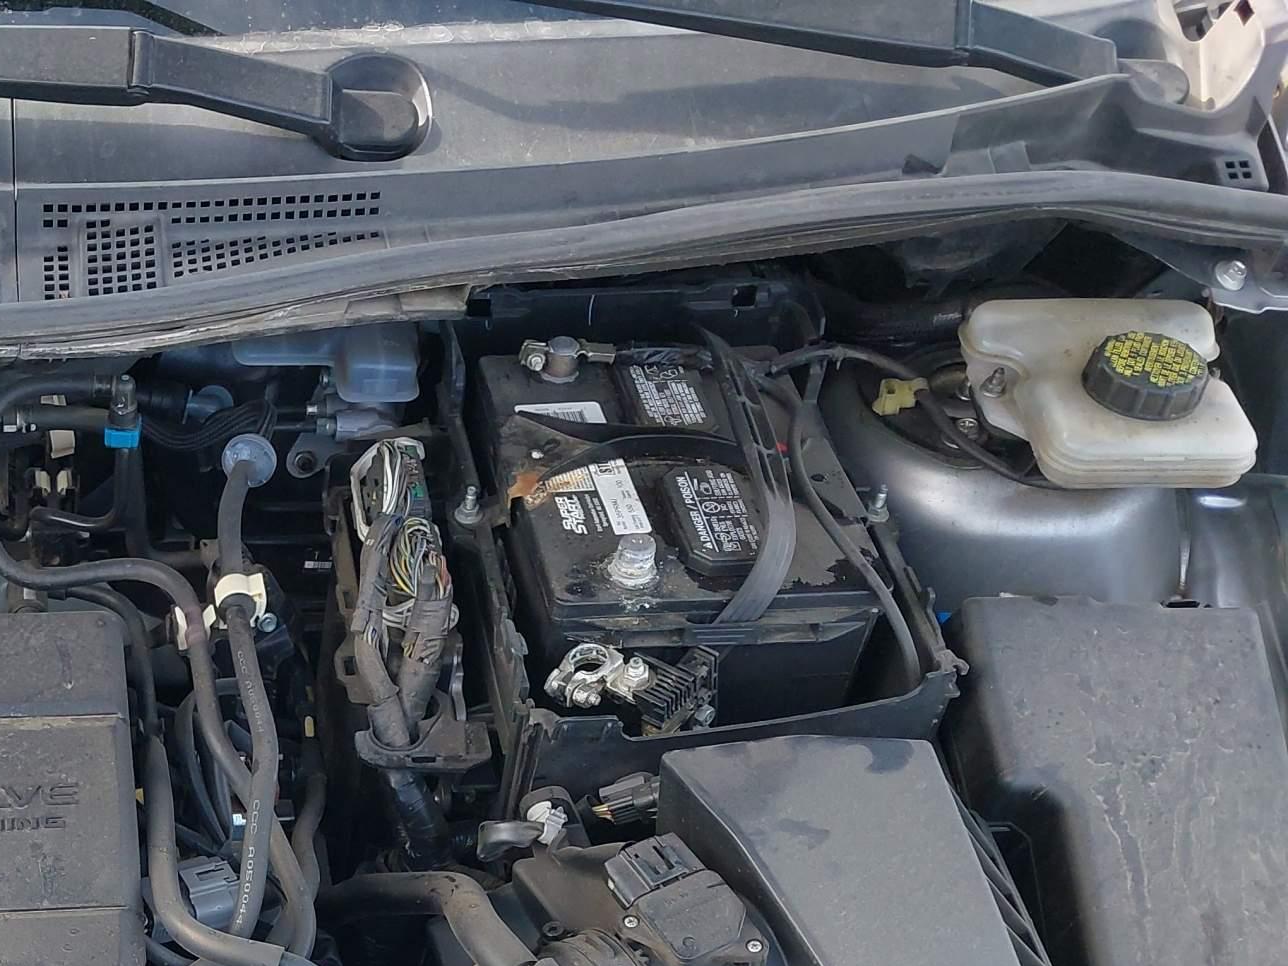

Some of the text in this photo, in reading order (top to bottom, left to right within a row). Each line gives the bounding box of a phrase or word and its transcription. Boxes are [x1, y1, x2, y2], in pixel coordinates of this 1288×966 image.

[675, 476, 696, 504] POISON
[555, 496, 573, 530] SUPER
[564, 494, 588, 534] START
[689, 510, 711, 542] DANGER
[235, 799, 260, 925] CCC A050044
